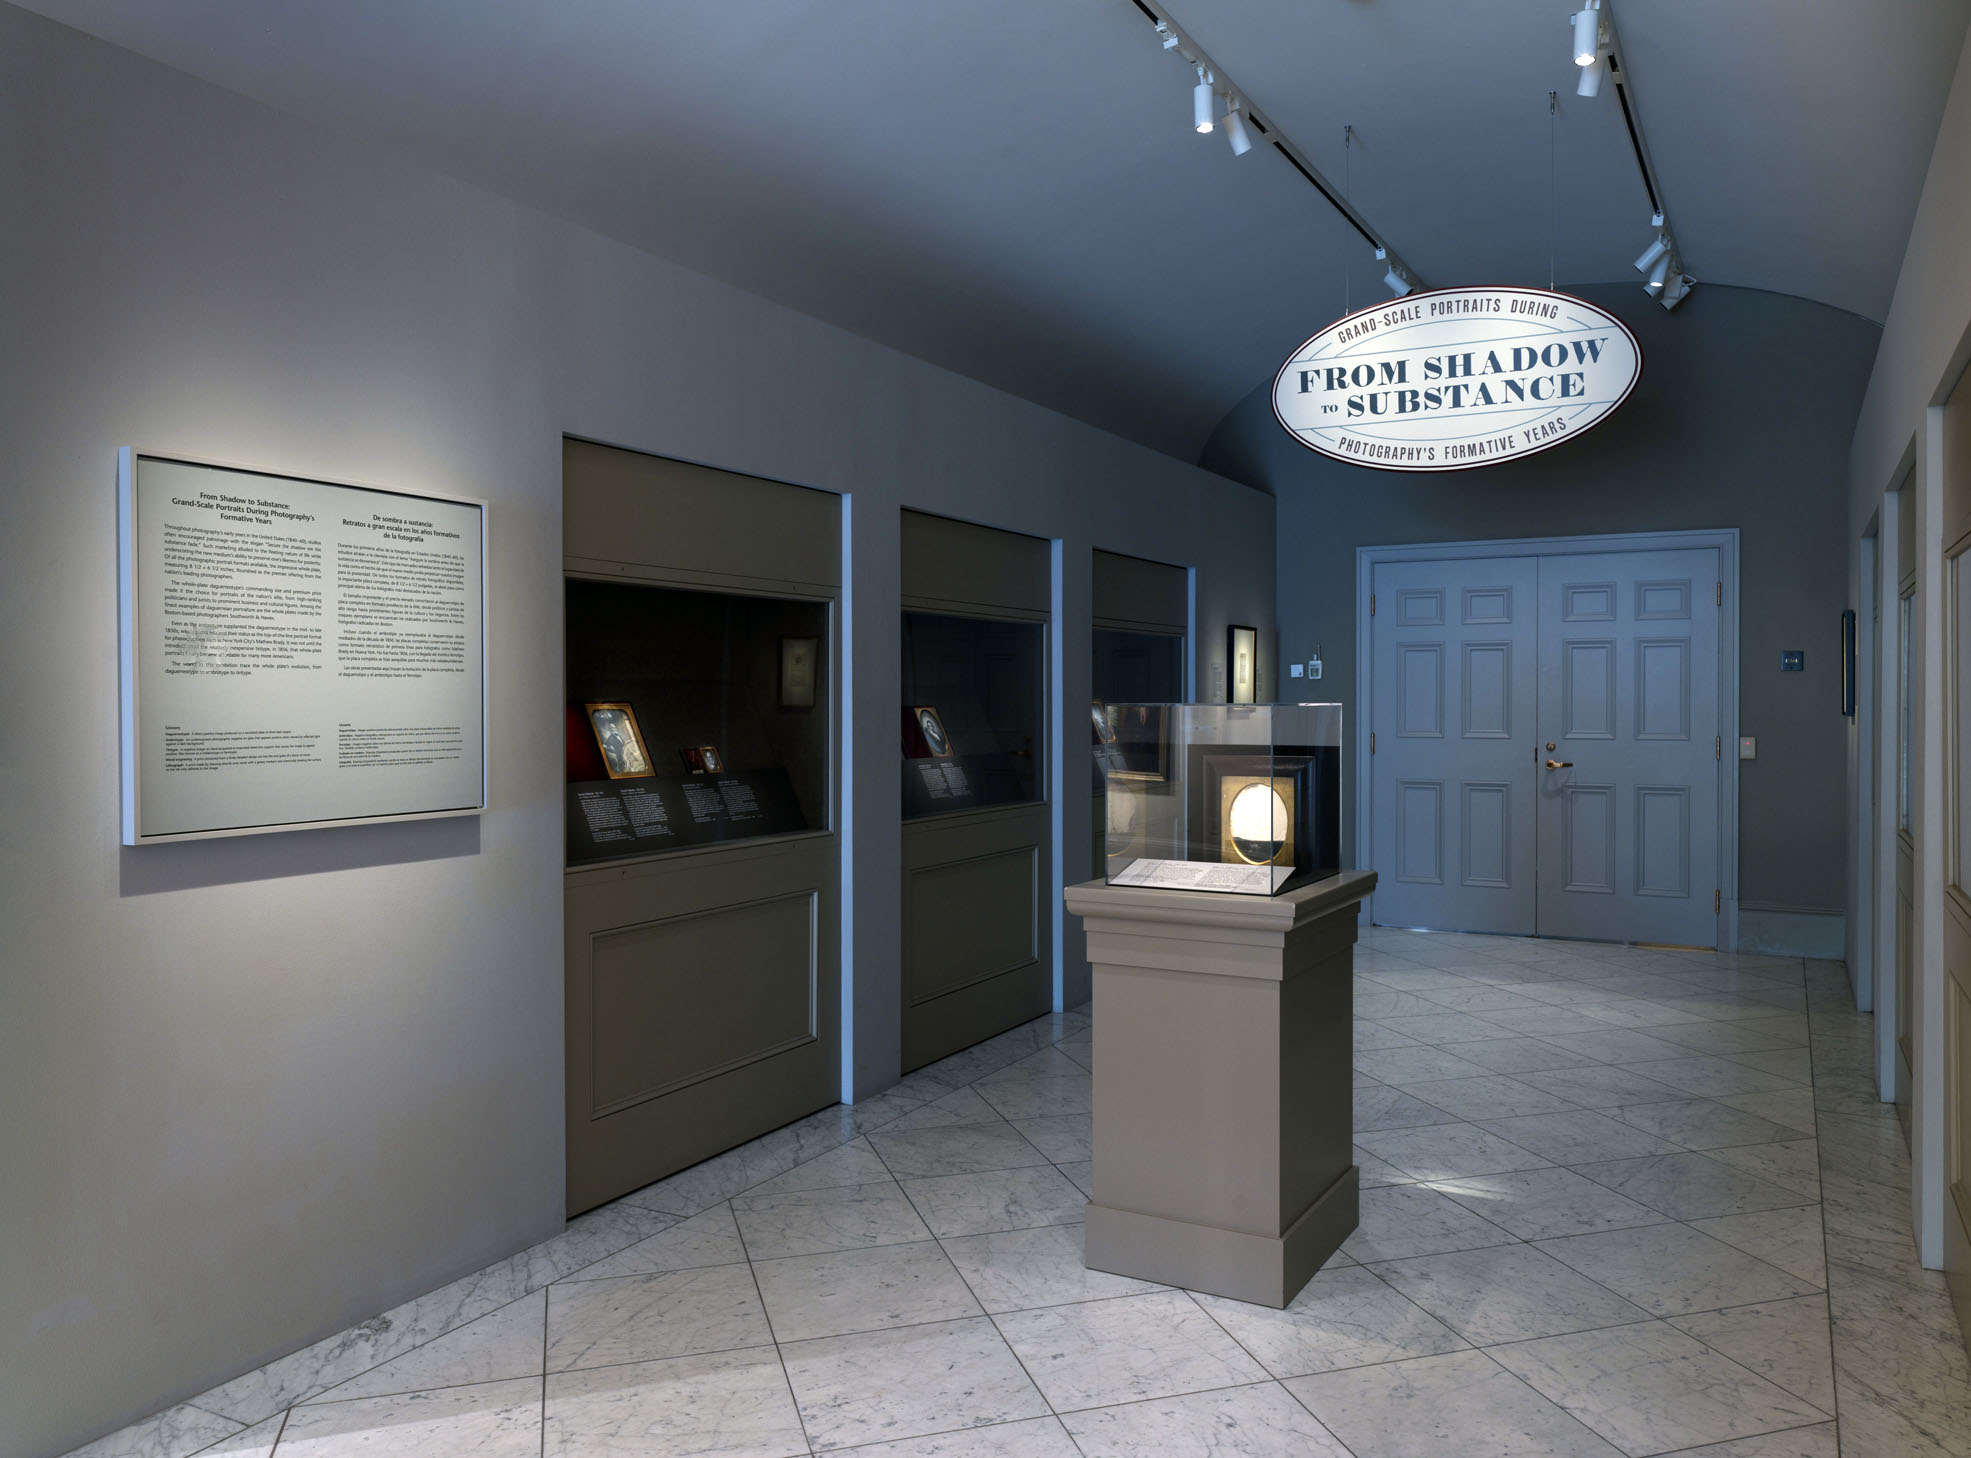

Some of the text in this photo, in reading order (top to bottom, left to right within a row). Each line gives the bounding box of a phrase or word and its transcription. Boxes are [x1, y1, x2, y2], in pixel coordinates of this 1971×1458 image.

[1338, 298, 1559, 344] GRAND-SCALE PORTRAITS DURING
[1297, 337, 1608, 394] FROM SHADOW
[1321, 372, 1585, 418] TO SUBSTANCE
[1338, 417, 1567, 461] PHOTOGRAPHY'S FORMATIVE YEARS
[172, 497, 315, 522] Grand-Scale Portraits During Photography's
[200, 491, 218, 500] From
[220, 494, 246, 504] Shadow
[257, 498, 290, 509] Substance:
[221, 512, 272, 524] Formative Years
[343, 518, 366, 527] Retratos
[387, 524, 402, 532] escala
[434, 529, 460, 538] formativos
[382, 515, 402, 524] sombra
[409, 518, 433, 527] sustancia:
[398, 533, 424, 542] fotografía
